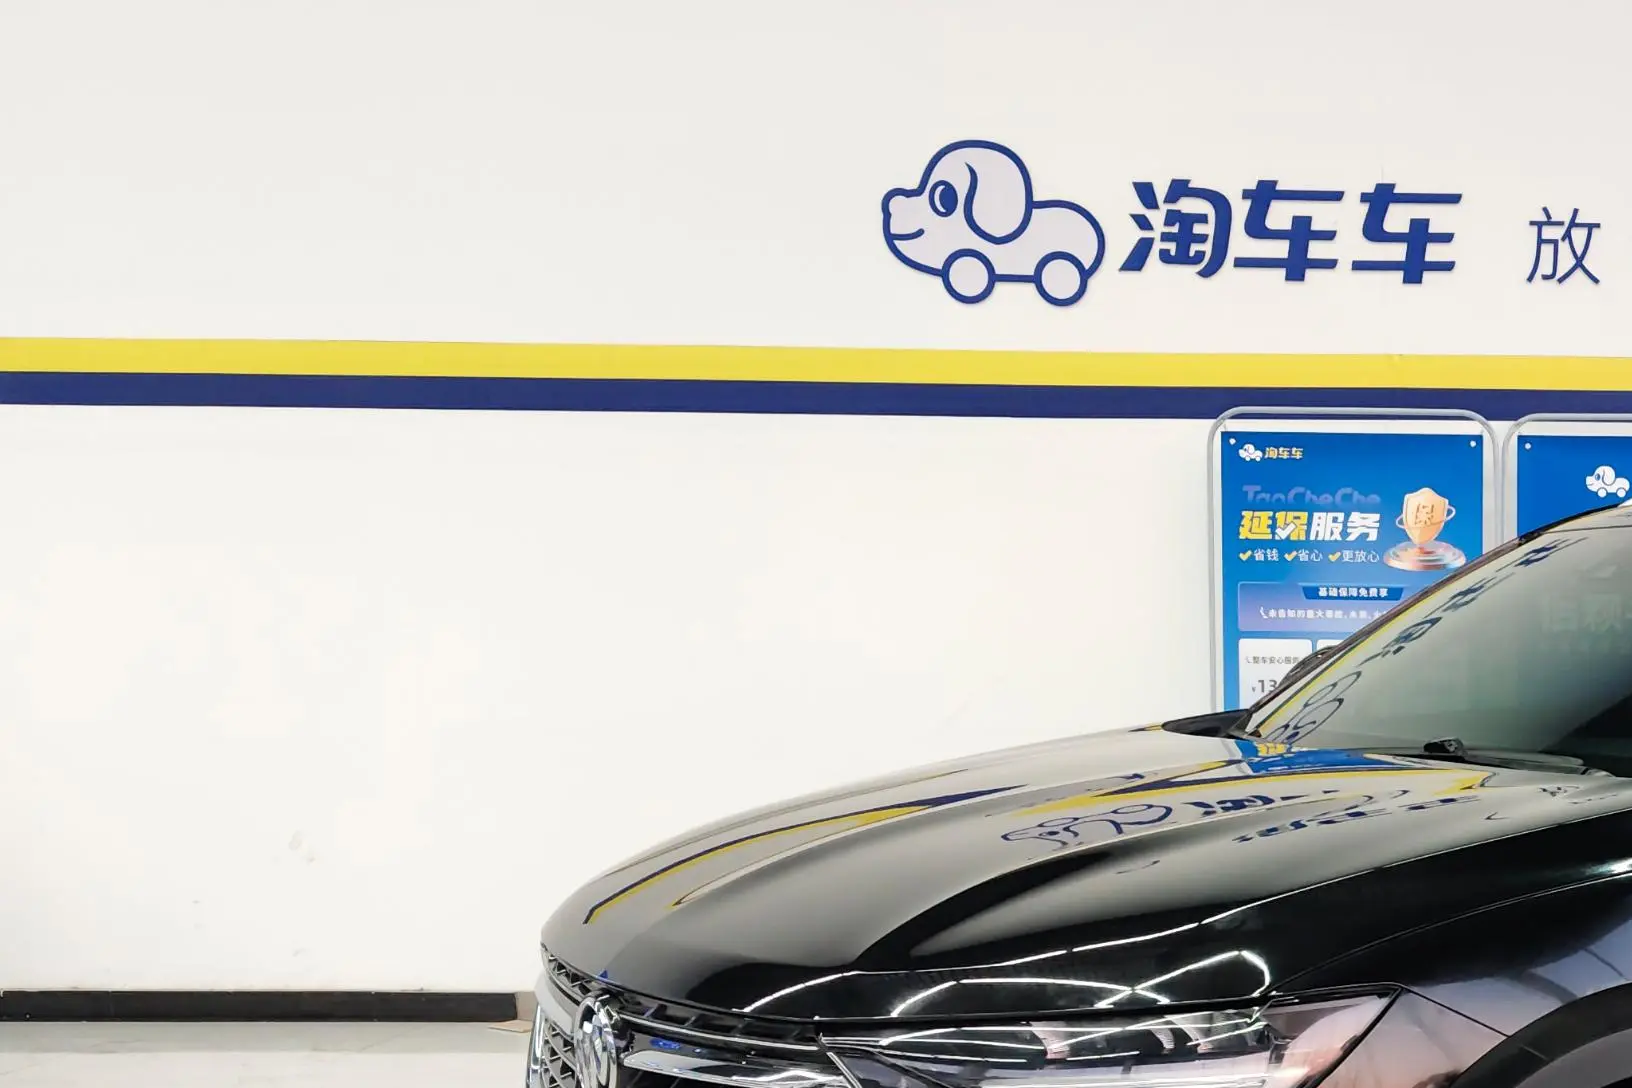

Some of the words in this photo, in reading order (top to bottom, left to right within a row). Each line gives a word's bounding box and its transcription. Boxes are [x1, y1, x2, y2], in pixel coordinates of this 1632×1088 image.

[1118, 178, 1463, 284] 淘车车
[1264, 447, 1303, 459] 淘车车
[1239, 511, 1380, 541] 延保服务
[1253, 548, 1279, 561] 省钱
[1297, 549, 1323, 562] 省心
[1342, 550, 1380, 563] 更放心
